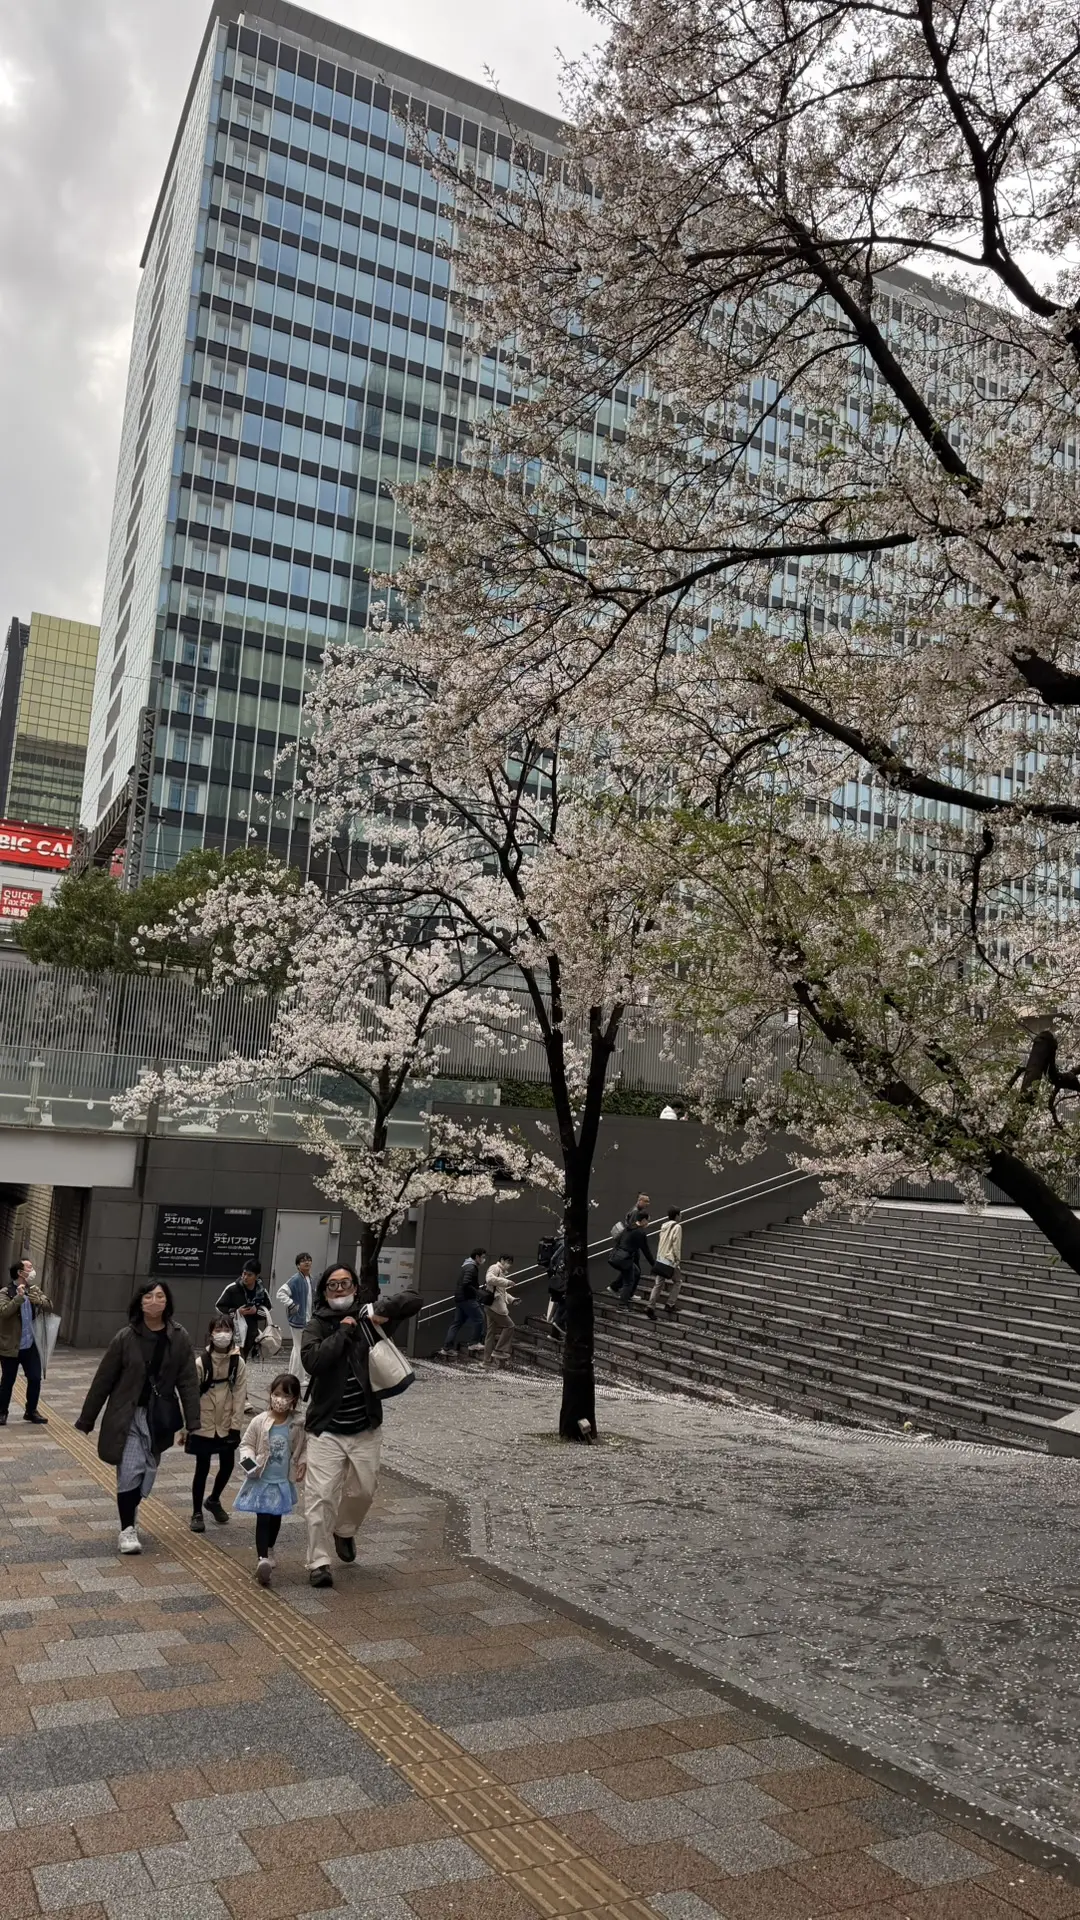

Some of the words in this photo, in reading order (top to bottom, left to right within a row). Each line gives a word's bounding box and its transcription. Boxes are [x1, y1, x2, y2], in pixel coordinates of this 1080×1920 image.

[0, 833, 32, 853] BIC
[3, 890, 34, 900] QUICK
[2, 897, 19, 906] Tax
[2, 906, 28, 917] 快速免
[213, 1236, 257, 1244] アキバプラザ
[157, 1247, 204, 1255] アキバシアター
